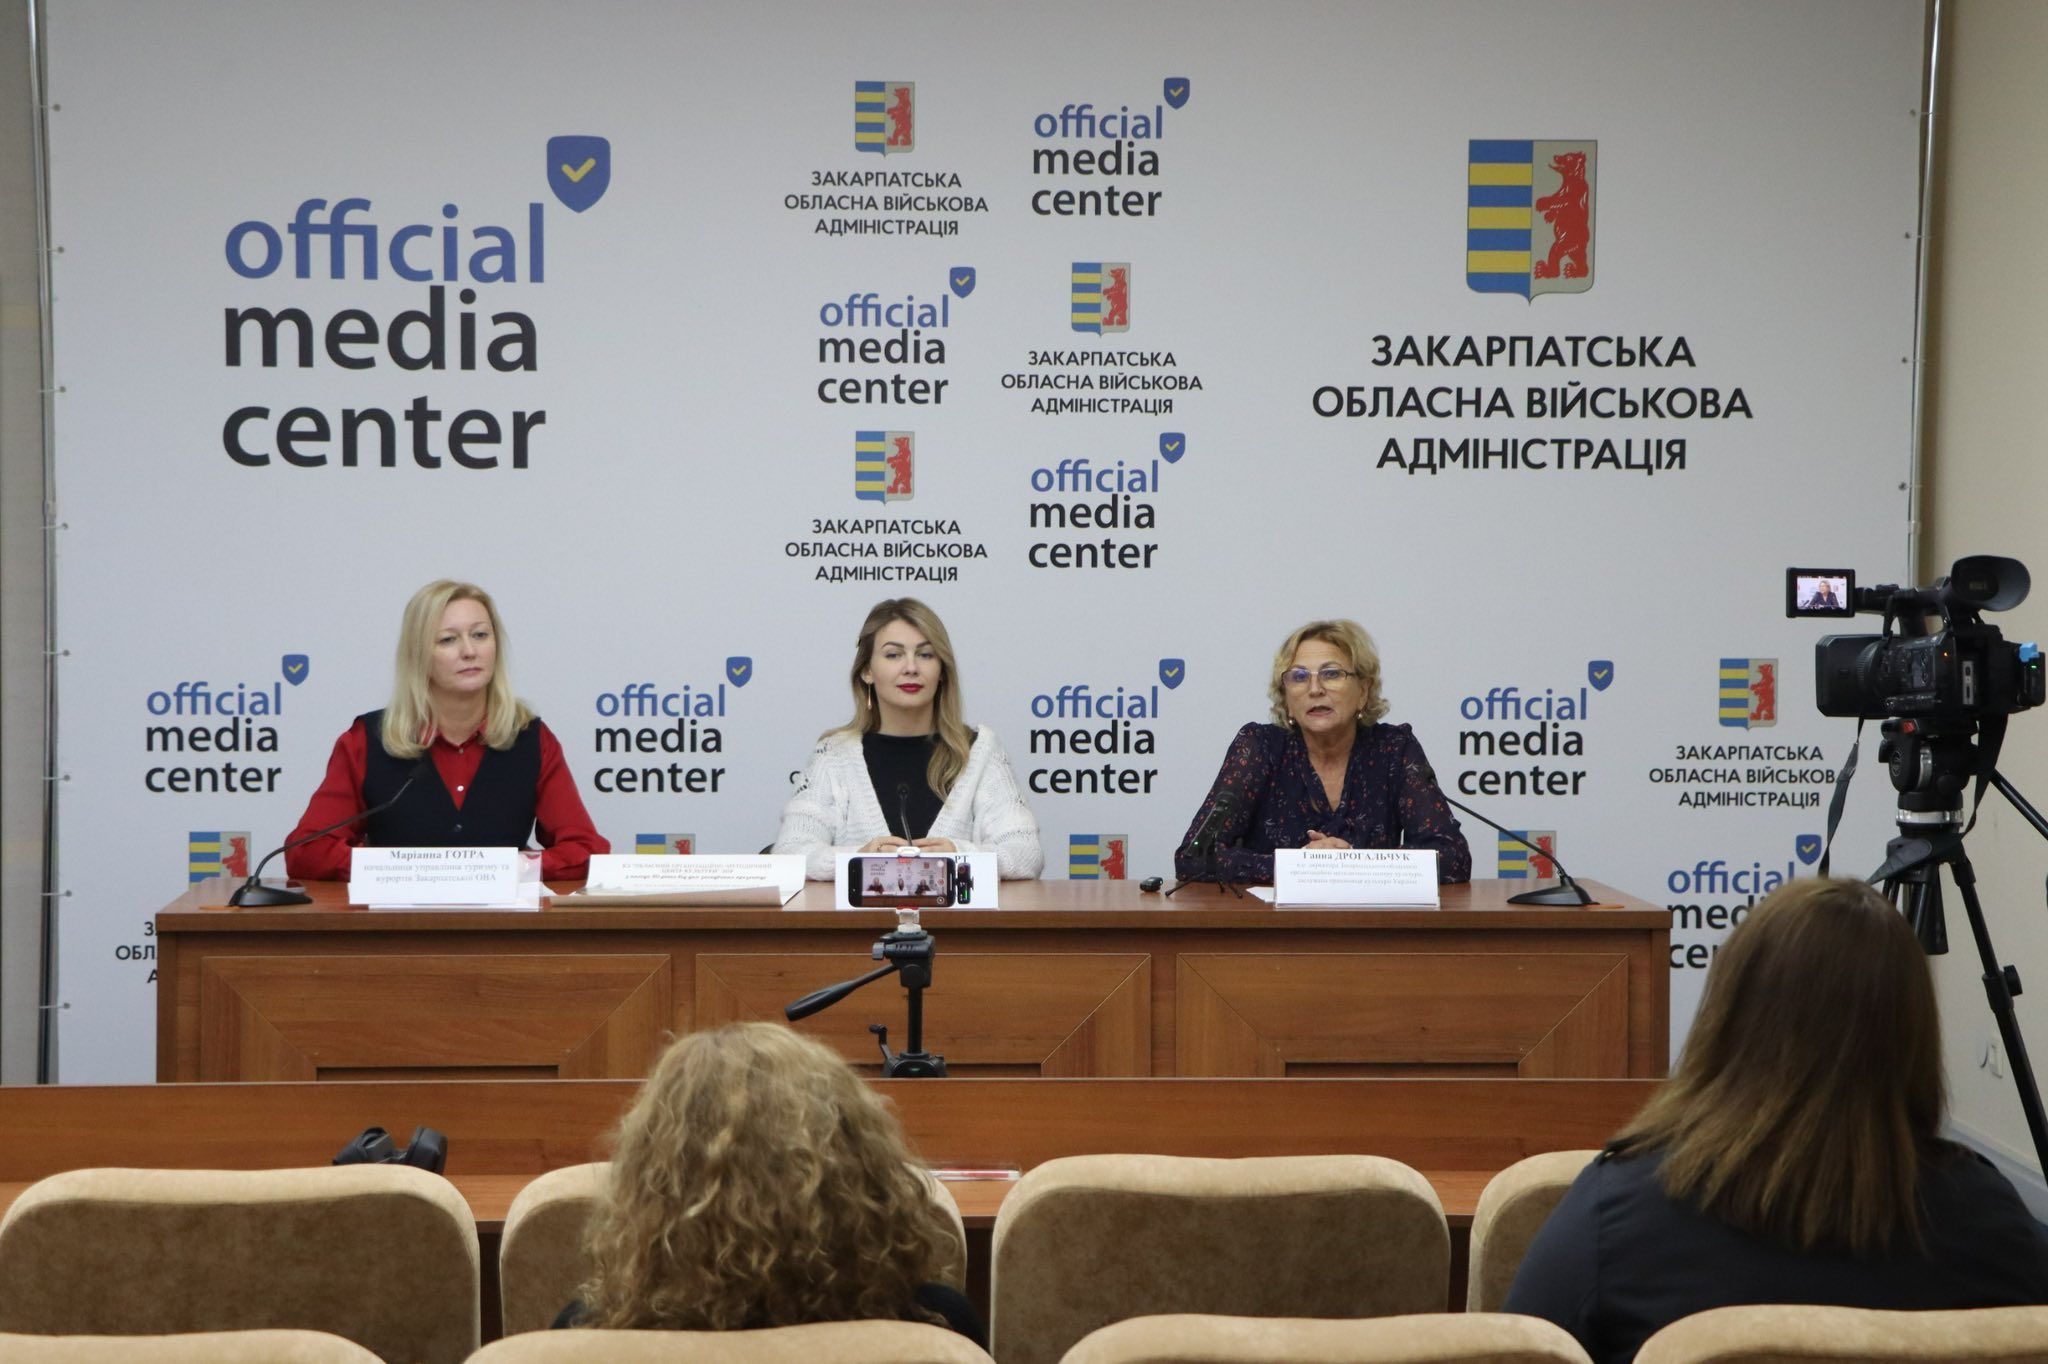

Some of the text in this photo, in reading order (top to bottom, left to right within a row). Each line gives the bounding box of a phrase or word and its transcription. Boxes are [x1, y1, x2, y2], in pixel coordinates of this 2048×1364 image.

[1034, 103, 1164, 140] official
[1033, 139, 1159, 176] media
[812, 171, 961, 187] ЗАКАРПАТСЬКА
[785, 194, 988, 211] ОБЛАСНА ВІЙСЬКОВА
[1031, 185, 1162, 217] center
[226, 198, 544, 282] official
[815, 219, 958, 237] АДМІНІСТРАЦІЯ
[820, 292, 948, 328] official
[224, 285, 537, 372] media
[819, 328, 945, 364] media
[1029, 351, 1176, 366] ЗАКАРПАТСЬКА
[1372, 335, 1696, 367] ЗАКАРПАТСЬКА
[817, 374, 949, 405] center
[1002, 373, 1202, 390] ОБЛАСНА ВІЙСЬКОВА
[1031, 398, 1172, 416] АДМІНІСТРАЦІЯ
[1313, 381, 1753, 418] ОБЛАСНА ВІЙСЬКОВА
[222, 396, 546, 470] center
[1377, 438, 1686, 475] АДМІНІСТРАЦІЯ
[1031, 459, 1158, 493] official
[813, 519, 961, 534] ЗАКАРПАТСЬКА
[1030, 493, 1155, 529] media
[786, 541, 987, 558] ОБЛАСНА ВІЙСЬКОВА
[1028, 538, 1158, 569] center
[816, 566, 957, 583] АДМІНІСТРАЦІЯ
[147, 681, 282, 716] official
[596, 681, 726, 717] official
[1030, 684, 1158, 719] official
[1461, 687, 1587, 721] official
[146, 716, 278, 752] media
[595, 717, 722, 753] media
[1030, 719, 1155, 755] media
[1459, 721, 1583, 757] media
[1677, 746, 1823, 760] ЗАКАРПАТСЬКА
[145, 762, 282, 793] center
[594, 763, 725, 793] center
[1028, 764, 1158, 794] center
[1457, 764, 1588, 796] center
[1650, 766, 1838, 785] ОБЛАСНА ВІЙСЬКОВ
[1679, 792, 1819, 809] АДМІНІСТРАЦІЯ
[390, 850, 442, 862] Маріанна
[1303, 852, 1410, 862] Ганна ДРОГАЛЬЧУК
